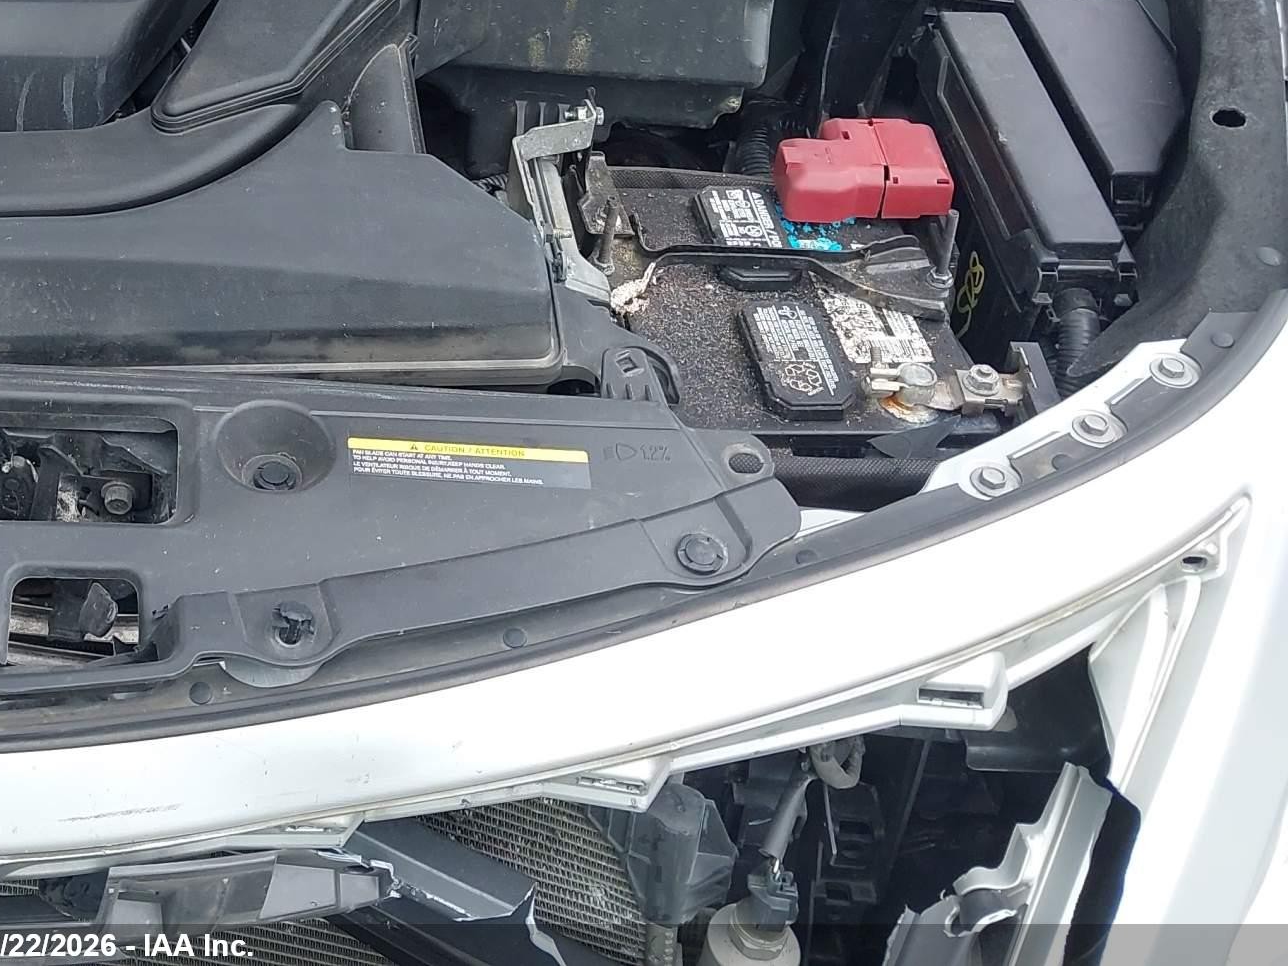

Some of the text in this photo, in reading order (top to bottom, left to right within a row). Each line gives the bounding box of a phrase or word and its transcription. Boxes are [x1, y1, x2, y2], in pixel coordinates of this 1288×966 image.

[754, 199, 774, 230] DANGER
[424, 444, 465, 453] CAUTION
[475, 446, 525, 456] ATTENTION
